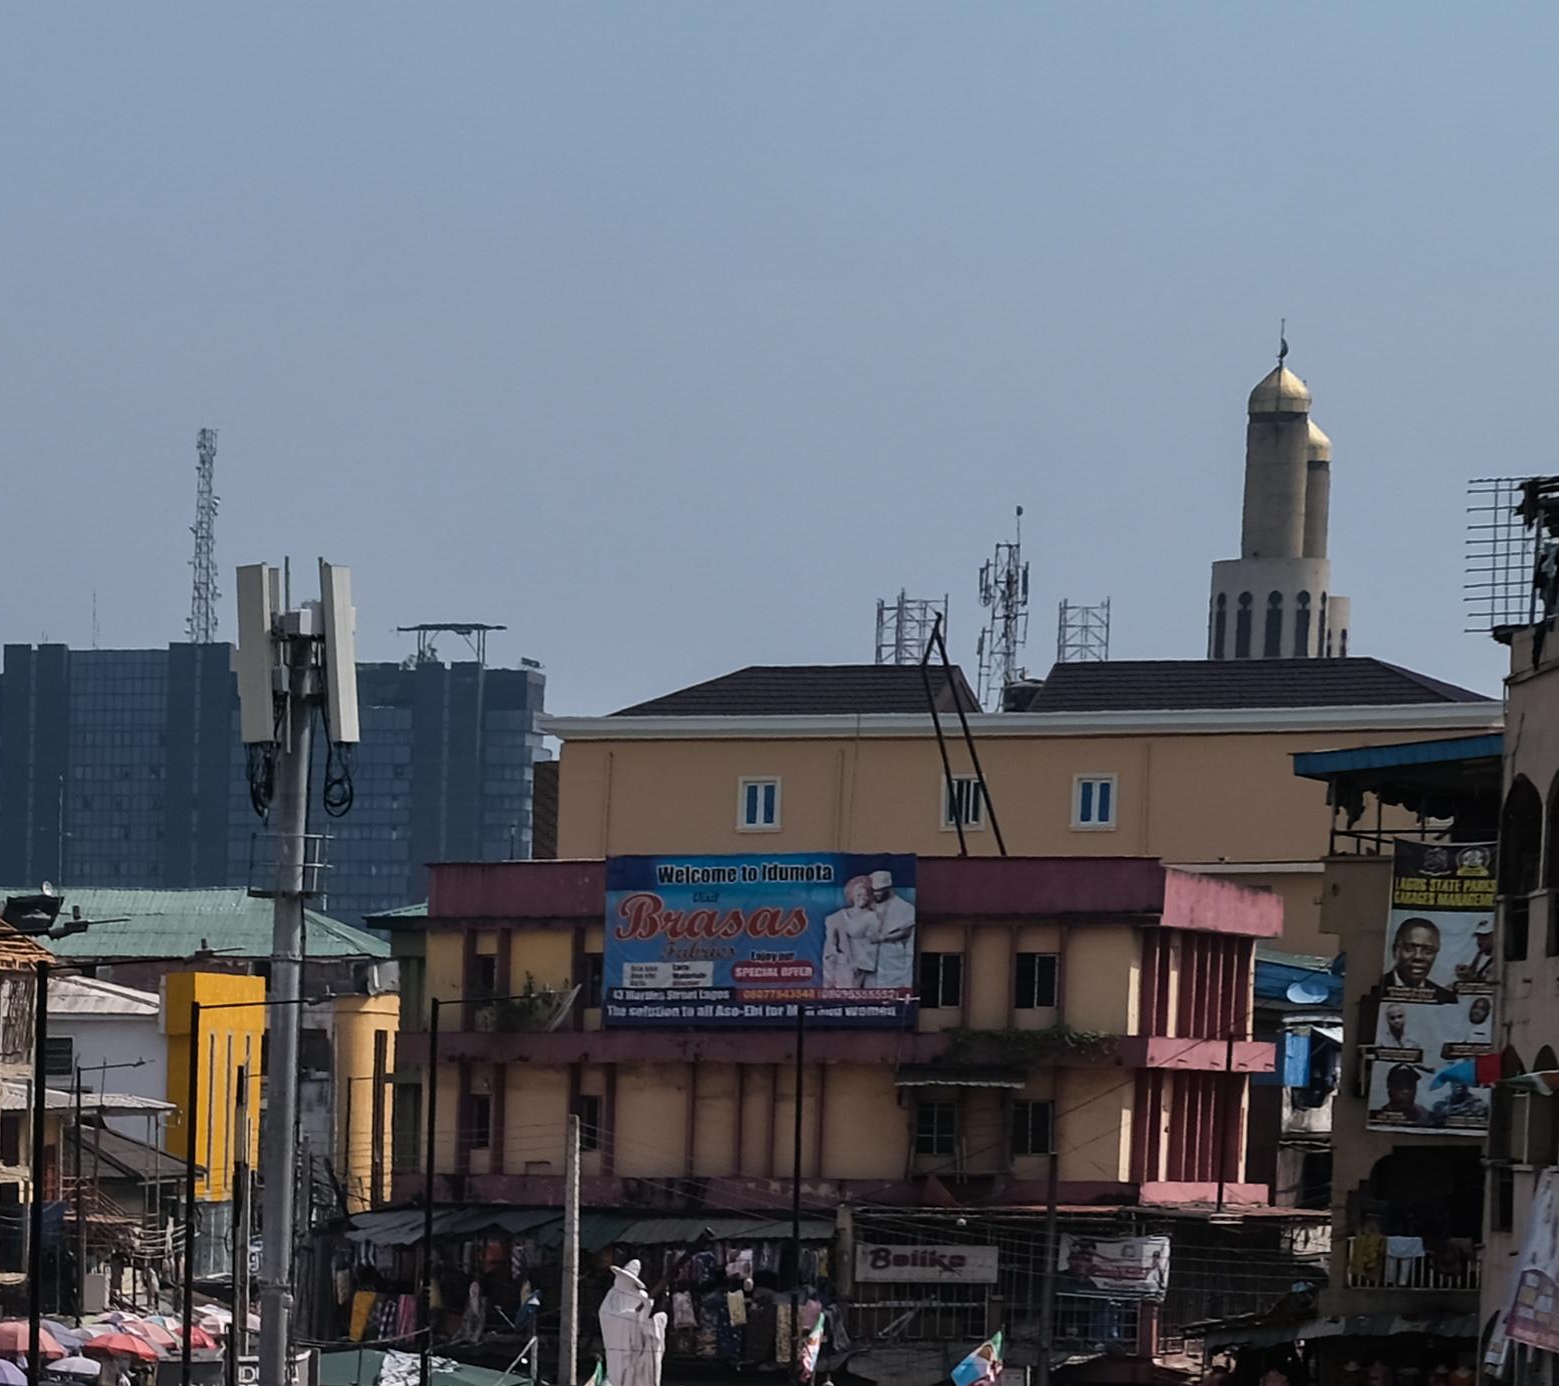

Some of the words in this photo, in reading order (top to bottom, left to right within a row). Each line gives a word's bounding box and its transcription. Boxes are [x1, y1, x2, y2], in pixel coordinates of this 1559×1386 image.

[657, 865, 737, 884] Welcome
[740, 866, 758, 883] to
[760, 863, 834, 881] Idumota
[615, 892, 808, 941] Brasas
[734, 966, 776, 978] SPECIAL
[779, 966, 813, 978] OFFER
[699, 988, 730, 1000] Lagos
[607, 1005, 626, 1017] The
[629, 1005, 679, 1017] solution
[682, 1006, 695, 1016] to
[697, 1004, 713, 1016] all
[765, 1004, 784, 1016] for
